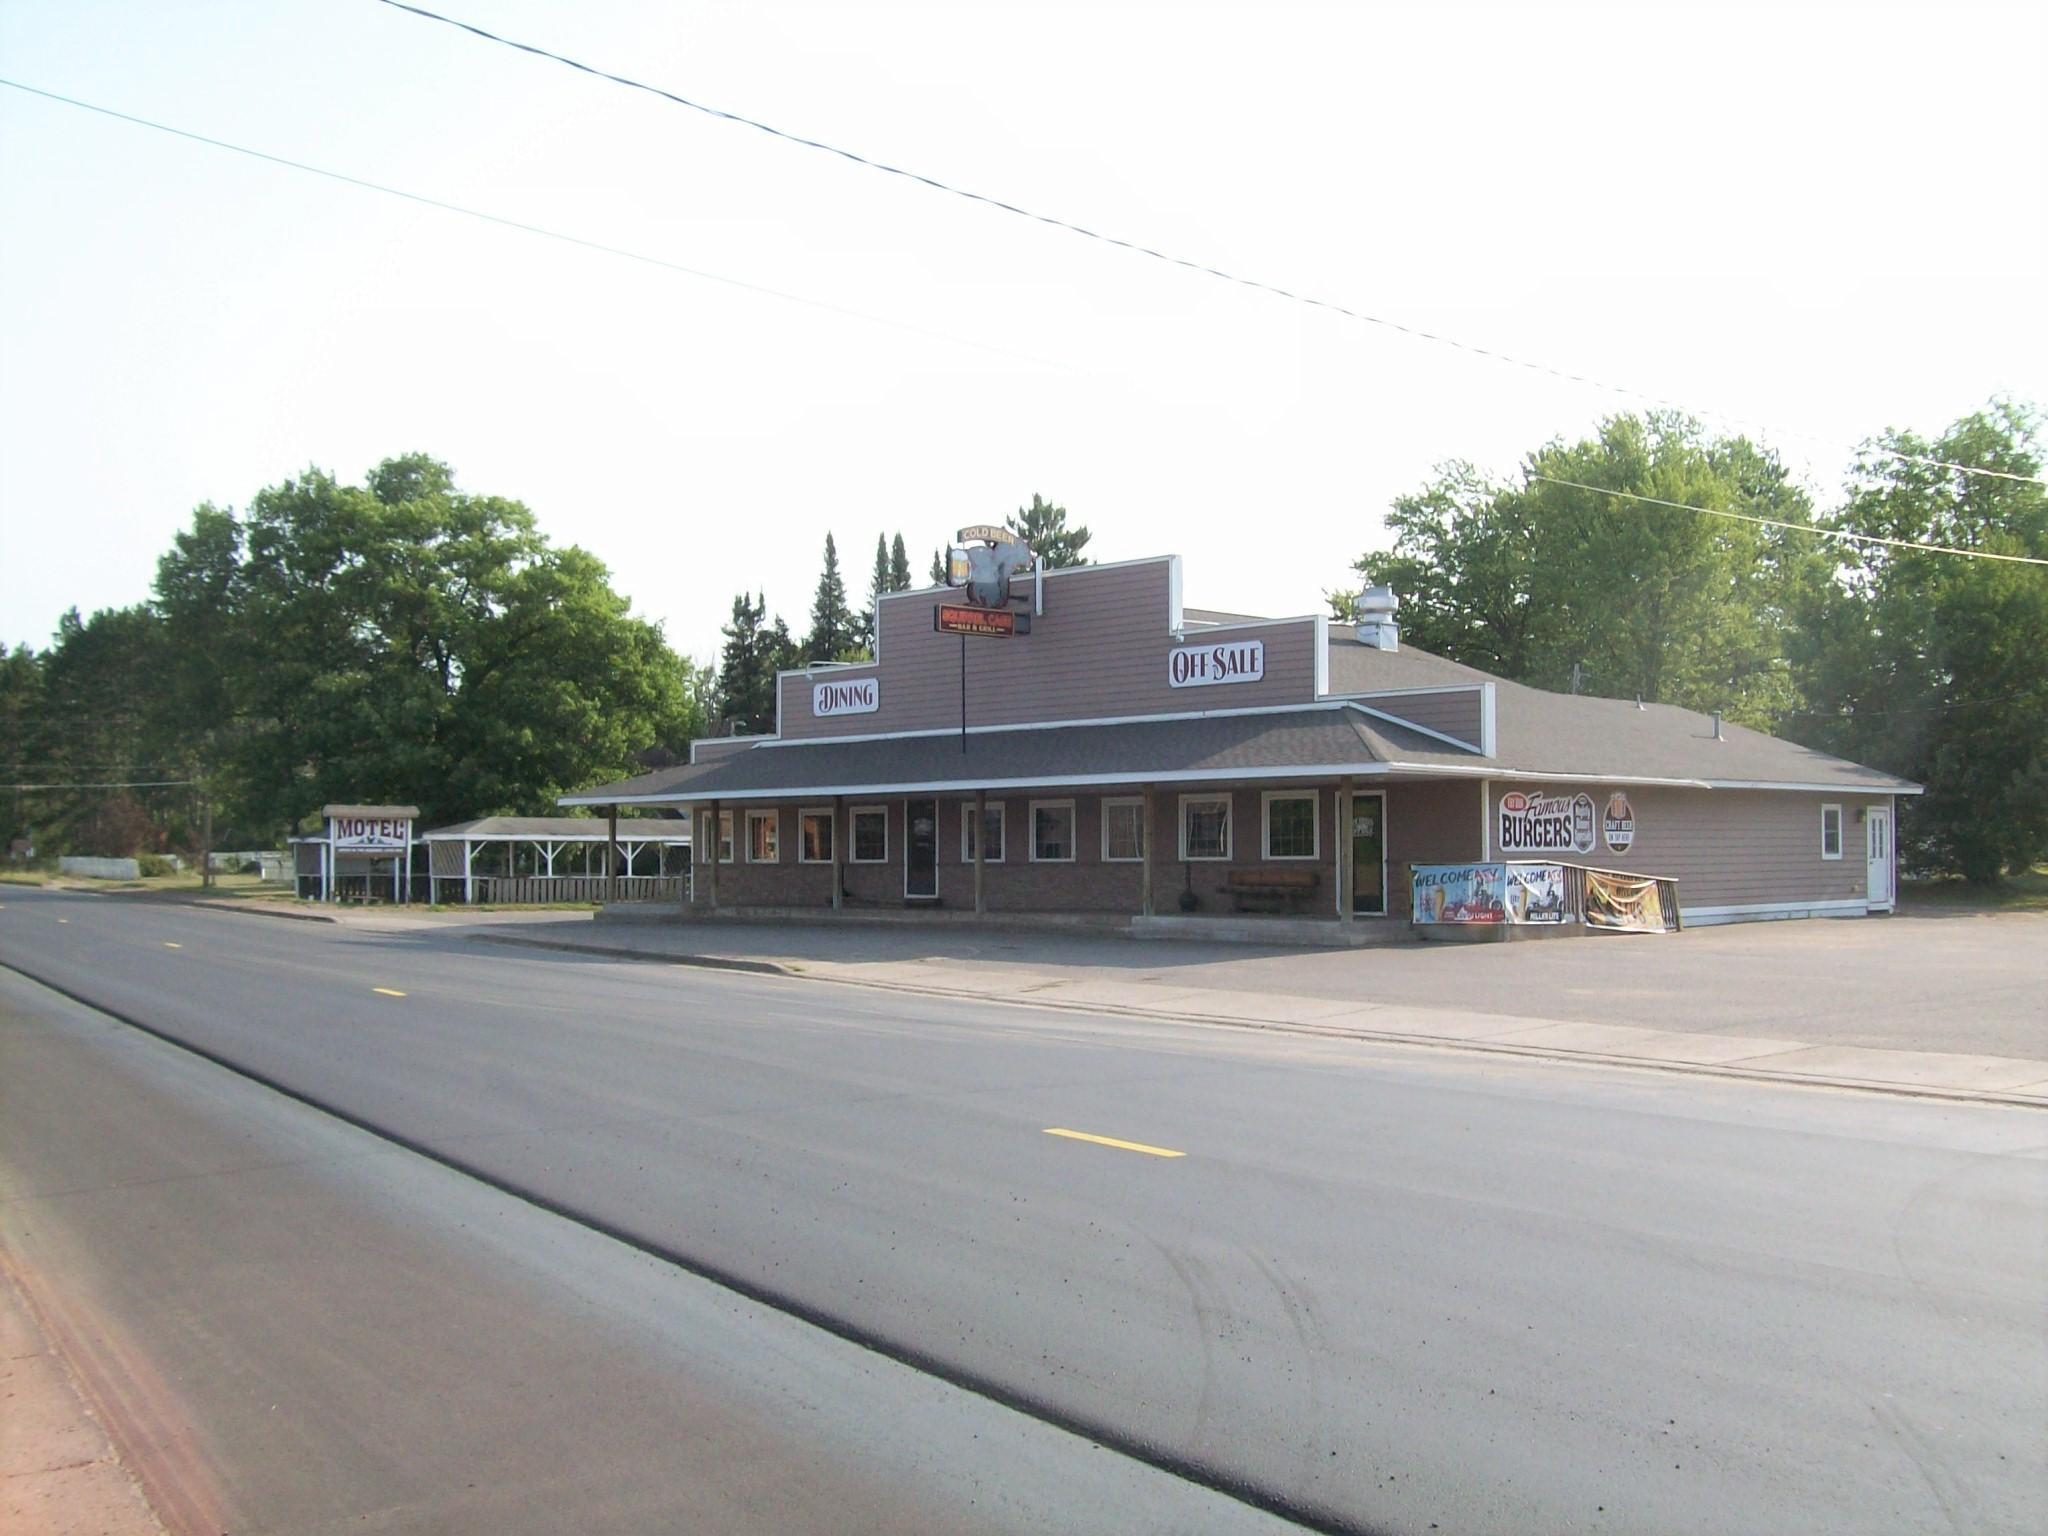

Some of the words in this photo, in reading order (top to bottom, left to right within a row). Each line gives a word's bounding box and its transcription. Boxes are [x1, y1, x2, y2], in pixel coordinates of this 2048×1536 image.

[963, 529, 989, 539] COLD
[978, 624, 996, 632] GRILL
[1172, 651, 1210, 683] OFF
[1212, 647, 1260, 680] SALE
[819, 684, 873, 713] DINING
[1523, 794, 1570, 822] Famous
[337, 818, 404, 839] MOTEL
[1501, 813, 1572, 848] BURGERS
[1416, 868, 1474, 887] WELCOME
[1506, 870, 1547, 887] WELCOME
